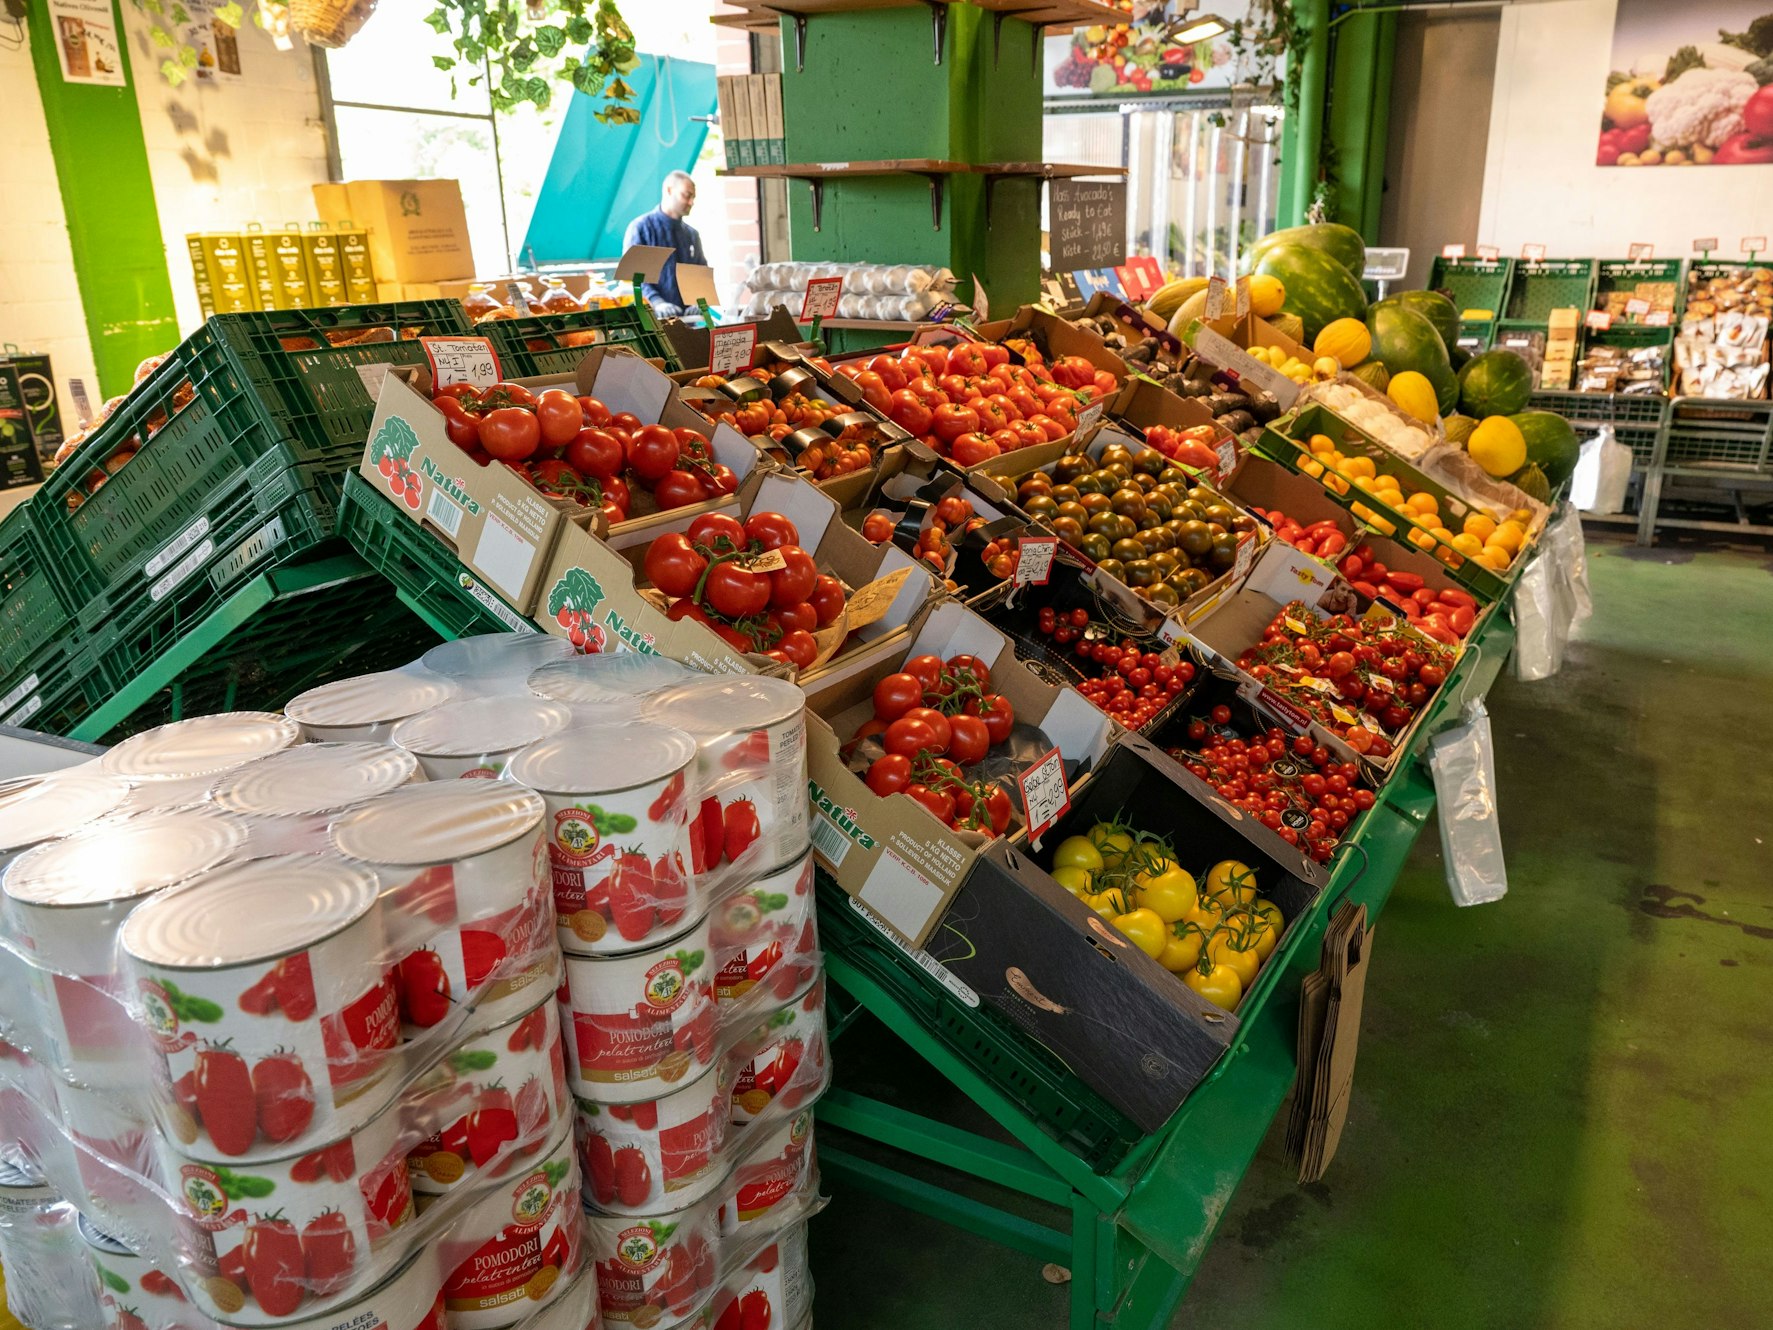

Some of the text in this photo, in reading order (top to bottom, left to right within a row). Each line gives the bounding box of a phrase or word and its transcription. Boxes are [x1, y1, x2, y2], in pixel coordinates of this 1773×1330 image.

[1058, 204, 1112, 226] Ready to Eat
[1063, 243, 1080, 258] Kiste
[447, 344, 489, 352] Tomaten
[472, 362, 494, 381] 1,99
[421, 456, 480, 516] Natura
[520, 503, 530, 512] KG
[528, 509, 546, 525] NETTO
[524, 496, 546, 515] KLASSE
[558, 809, 590, 818] SELEZIONI
[557, 852, 606, 866] ALIMENTARI
[897, 831, 957, 879] PRODUCT OF HOLLAND
[929, 844, 940, 855] KG
[939, 852, 961, 871] NETTO
[937, 839, 962, 861] KLASSE
[894, 839, 925, 865] SOLLEVELD
[923, 862, 952, 886] MAASDIJK
[650, 960, 678, 975] SELEZIONI
[647, 989, 690, 1016] ALIMENTARI
[610, 1022, 670, 1044] POMODORI
[614, 1066, 657, 1081] salsati
[474, 1238, 538, 1271] POMODORI
[505, 1252, 542, 1276] interi
[618, 1258, 661, 1274] ALIMENTARI
[480, 1286, 526, 1308] salsati
